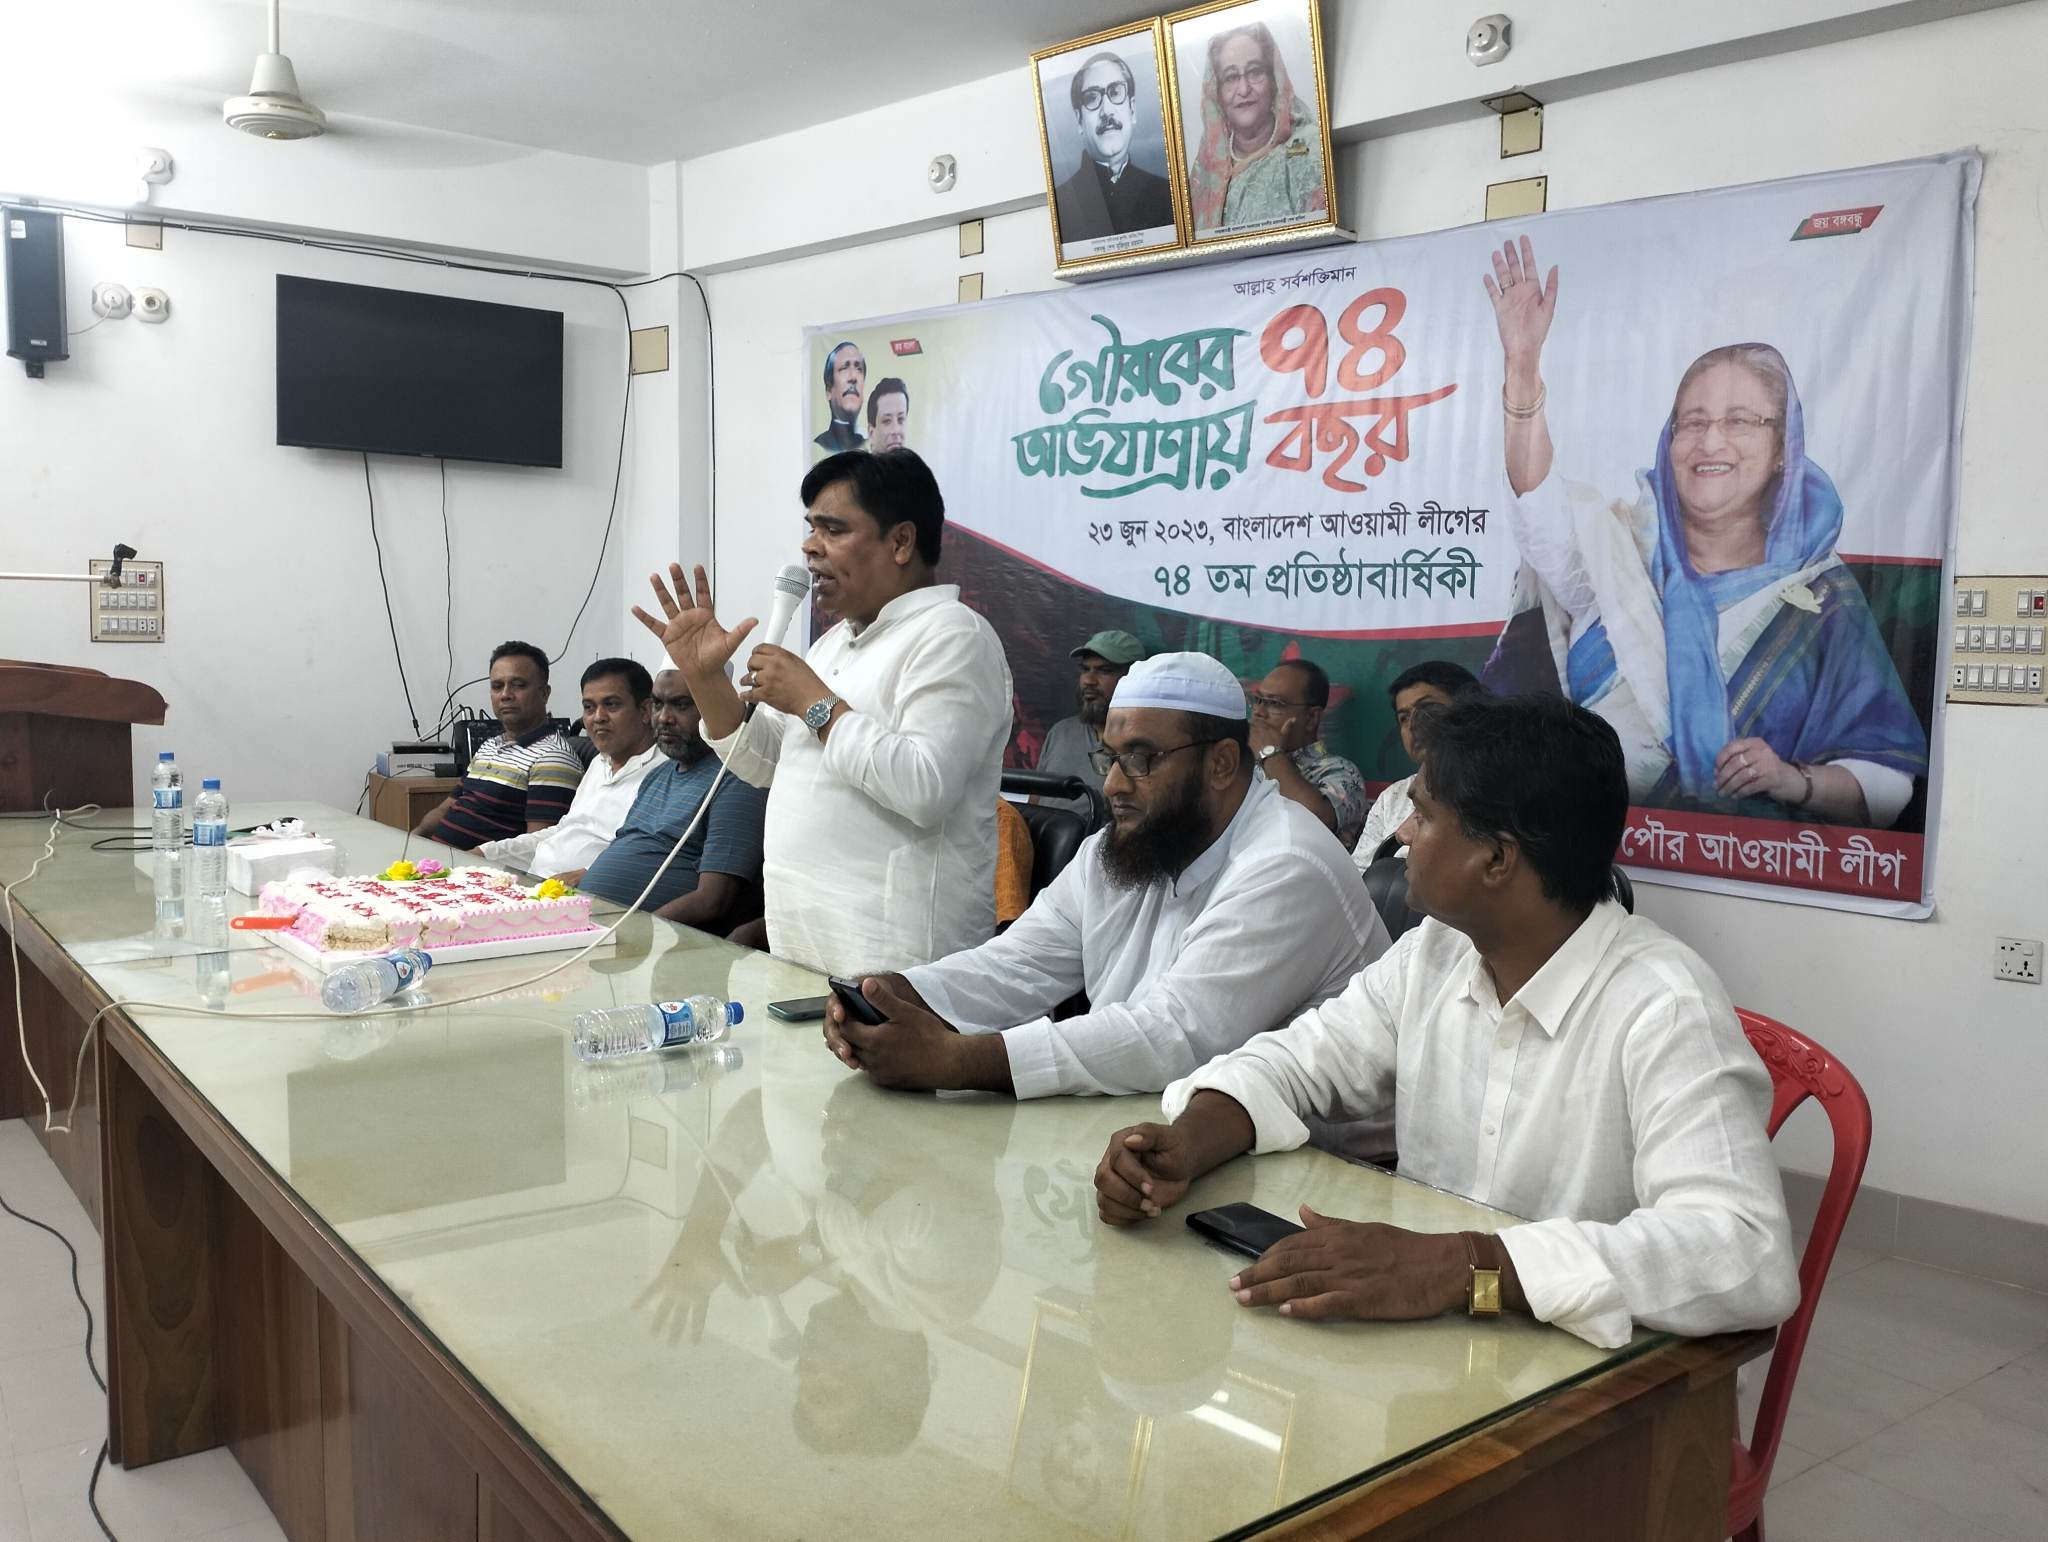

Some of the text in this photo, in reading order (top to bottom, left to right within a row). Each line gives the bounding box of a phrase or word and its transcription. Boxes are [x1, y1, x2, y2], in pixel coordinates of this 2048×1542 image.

[1280, 267, 1357, 289] সর্বশক্তিমান
[1039, 314, 1252, 414] গৌরবের
[1259, 287, 1408, 398] ৭৪
[1263, 383, 1459, 493] বছর
[1088, 499, 1490, 548] ২৩ জুন ২০২৩, বাংলাদেশ আওয়ামী লীগের
[1153, 546, 1485, 601] ৭৪ তম প্রতিষ্ঠাবার্ষিকী
[1621, 814, 1908, 892] পৌর আওয়ামী লীগ
